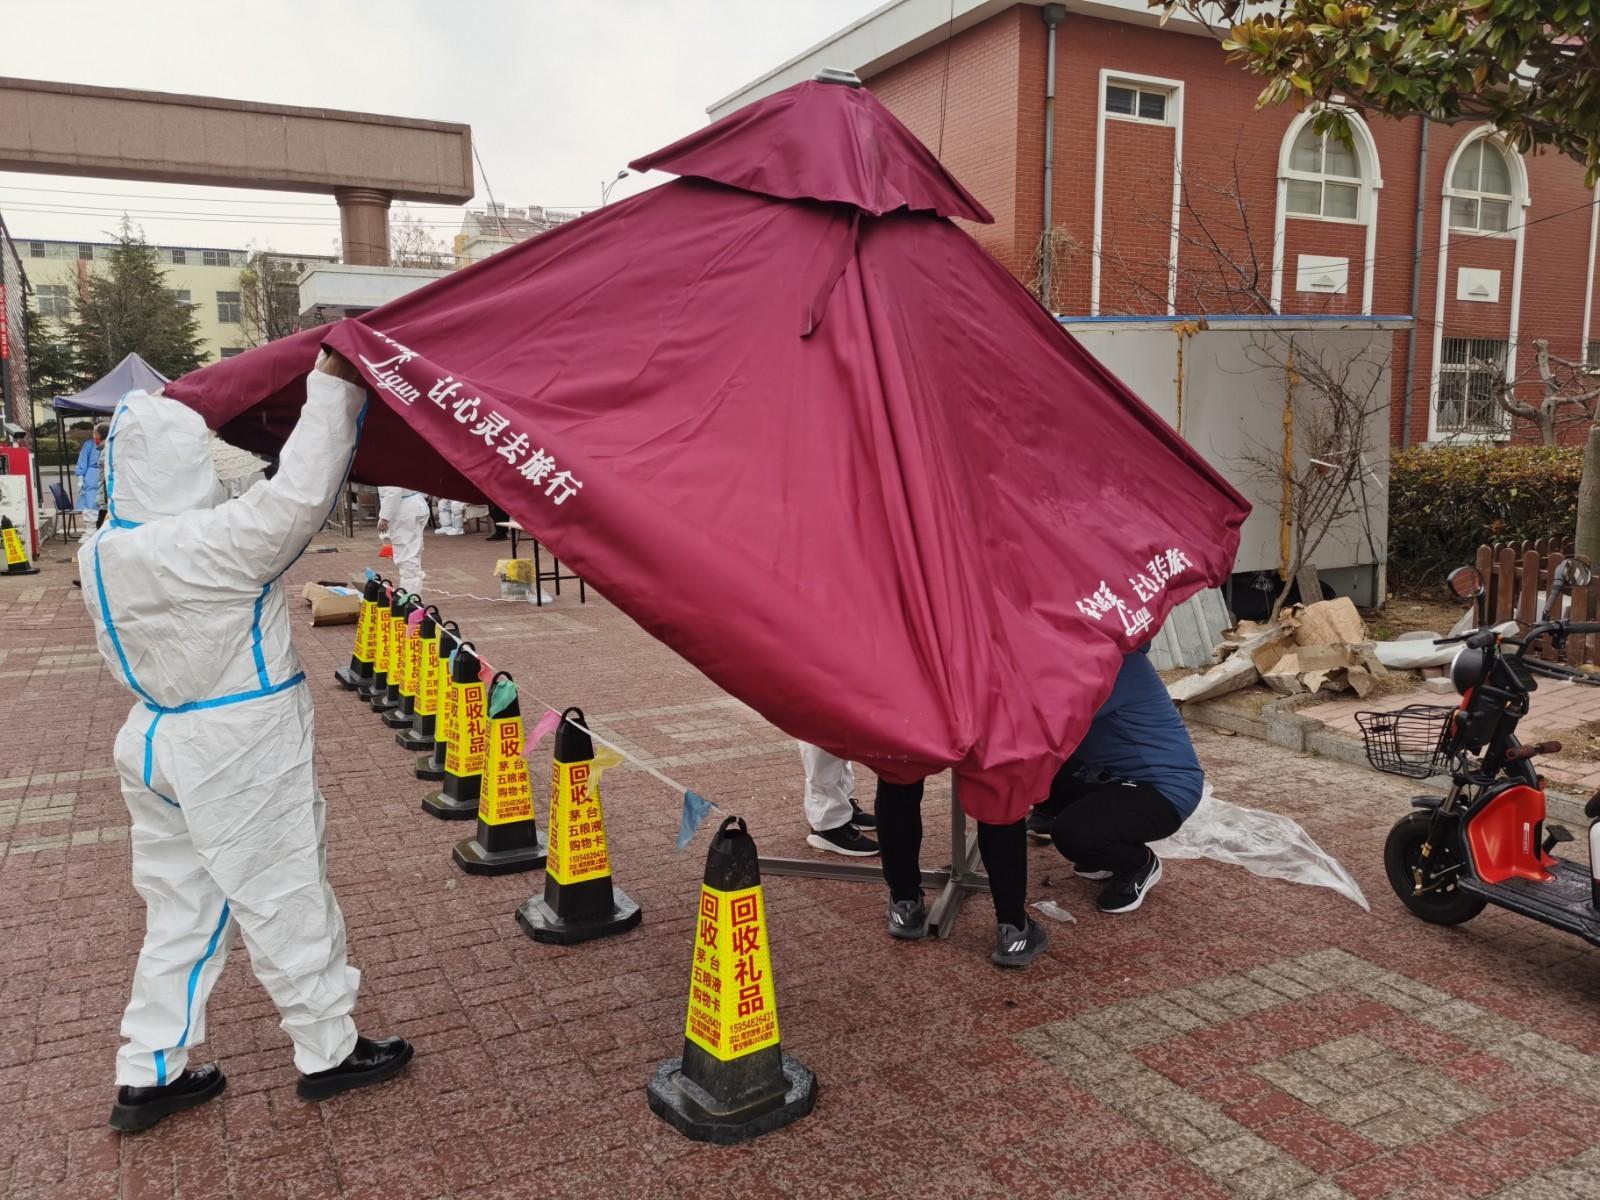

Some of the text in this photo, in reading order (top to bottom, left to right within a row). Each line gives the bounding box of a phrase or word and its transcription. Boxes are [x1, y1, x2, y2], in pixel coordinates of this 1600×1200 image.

[357, 352, 421, 405] Ligun
[427, 375, 583, 505] 让心灵去旅行
[465, 686, 485, 753] 回收礼品
[500, 722, 520, 758] 回收
[496, 772, 528, 785] 五粮液
[498, 759, 525, 772] 茅台
[497, 784, 528, 798] 购物卡
[569, 764, 593, 805] 回收
[550, 763, 561, 851] 回收礼品
[569, 807, 598, 822] 茅台
[568, 820, 603, 838] 五粮液
[569, 835, 604, 852] 购物卡
[700, 890, 719, 950] 回收
[696, 947, 720, 971] 茅台
[730, 894, 765, 1018] 回收礼品
[692, 965, 722, 994] 五粮液
[692, 985, 721, 1013] 购物卡
